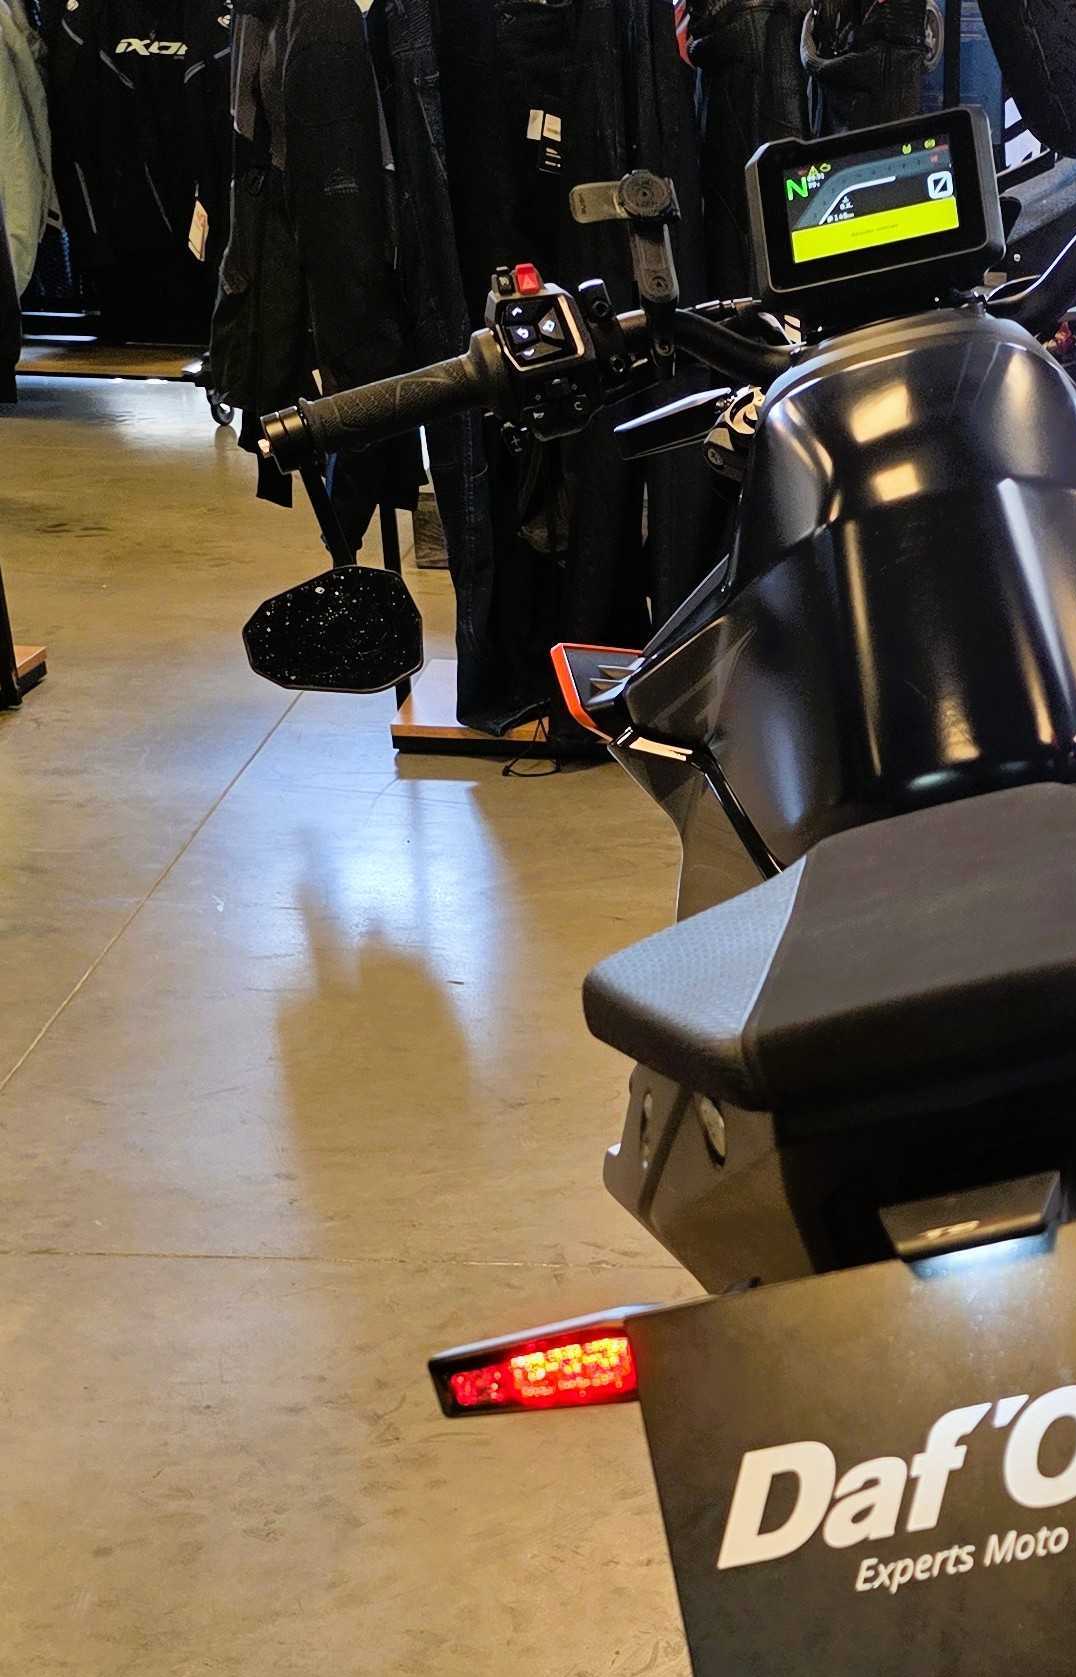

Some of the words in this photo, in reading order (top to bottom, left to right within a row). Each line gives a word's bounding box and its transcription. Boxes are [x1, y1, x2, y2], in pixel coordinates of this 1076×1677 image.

[786, 176, 809, 201] N
[855, 1541, 975, 1594] Experts
[984, 1523, 1070, 1567] Moto
